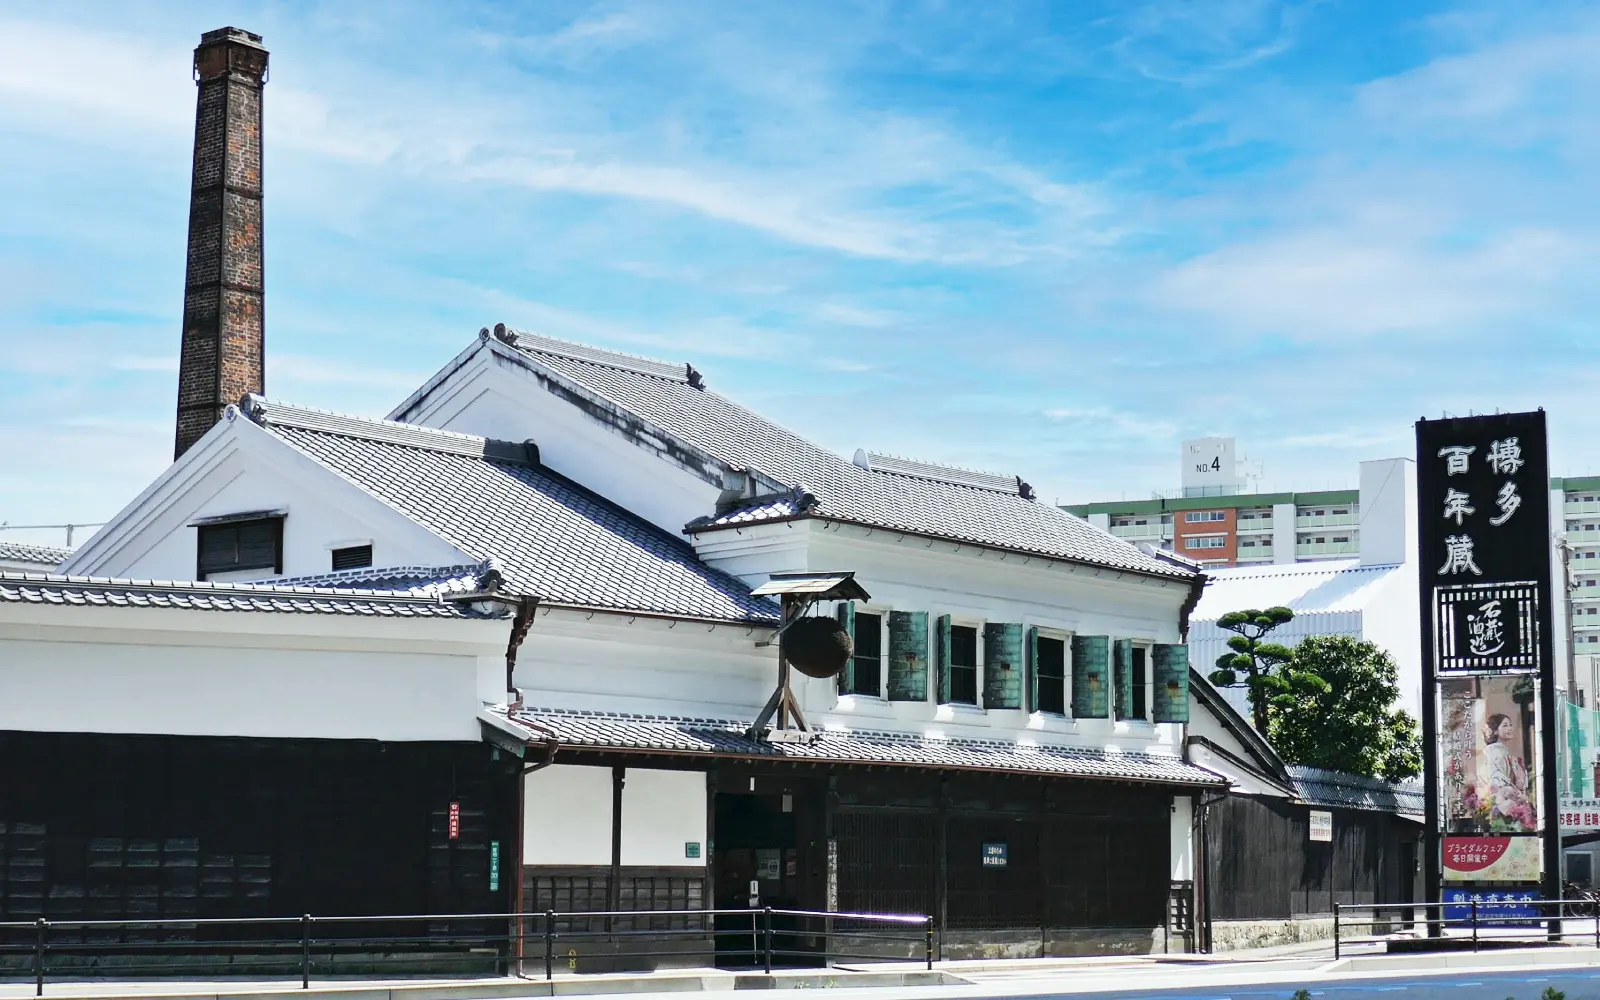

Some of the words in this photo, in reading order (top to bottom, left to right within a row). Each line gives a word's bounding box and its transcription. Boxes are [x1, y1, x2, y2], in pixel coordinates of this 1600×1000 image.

[1486, 436, 1525, 527] 博多
[1437, 445, 1483, 576] 百年蔵
[1447, 843, 1504, 853] ブライダルフェア
[1453, 893, 1532, 908] 製造直売中
